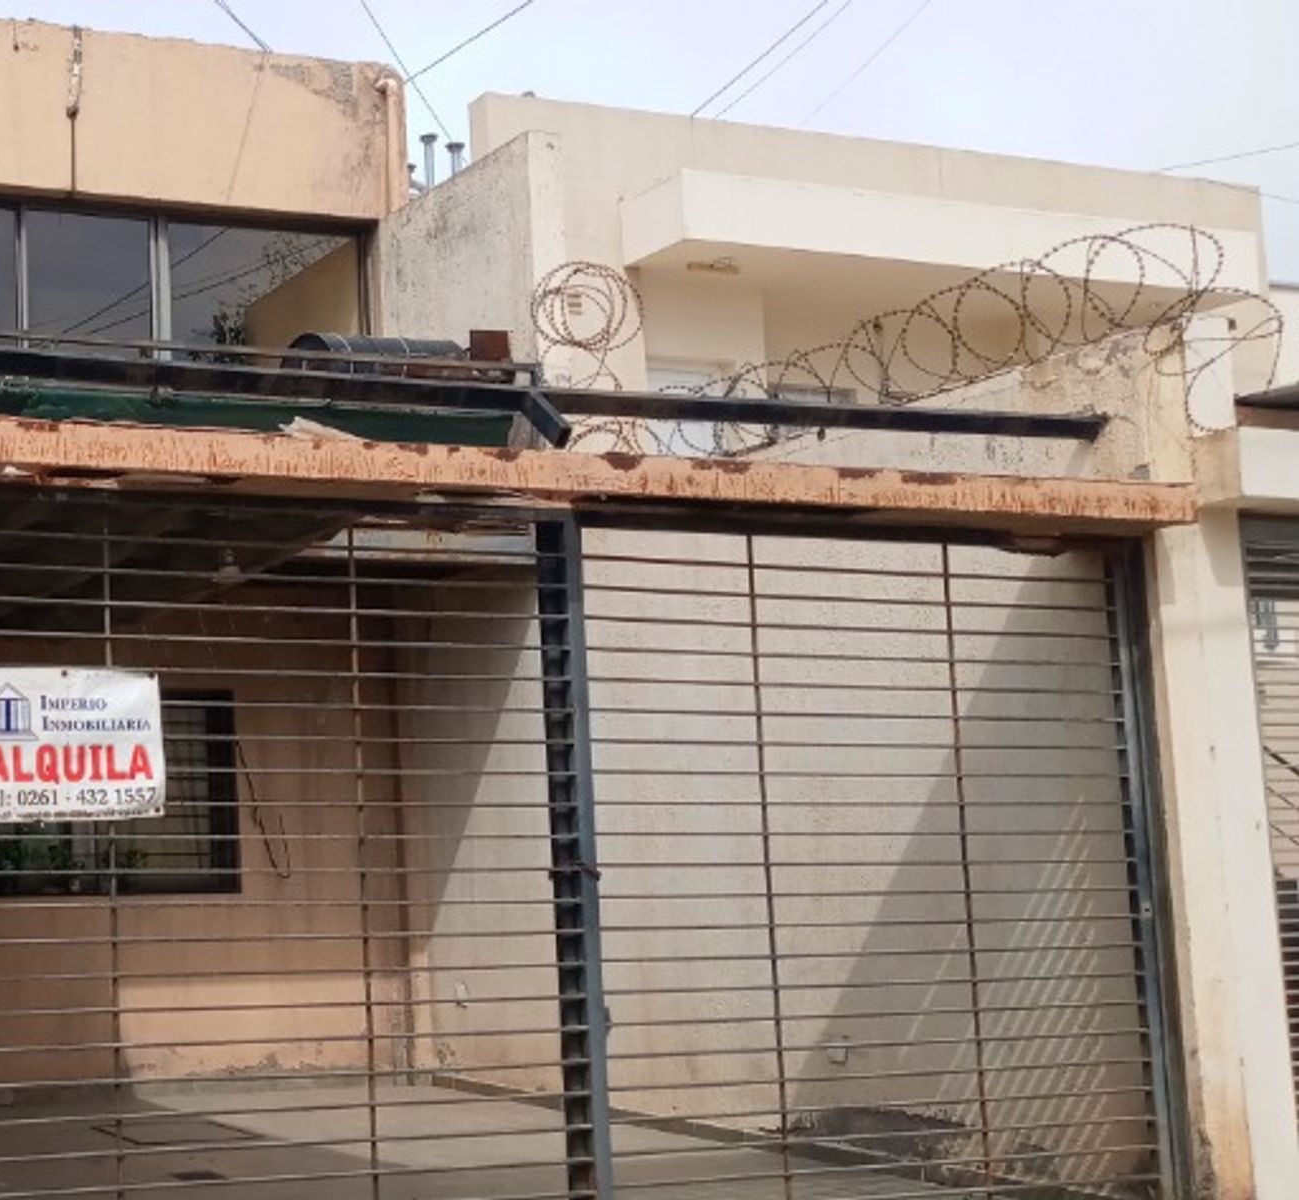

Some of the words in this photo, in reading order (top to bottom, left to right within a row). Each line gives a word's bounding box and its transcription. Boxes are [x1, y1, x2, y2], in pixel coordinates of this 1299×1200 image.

[40, 695, 108, 711] IMPERIO
[42, 715, 151, 732] INMOBILIARIA
[17, 788, 58, 806] 0261
[76, 788, 108, 805] 432
